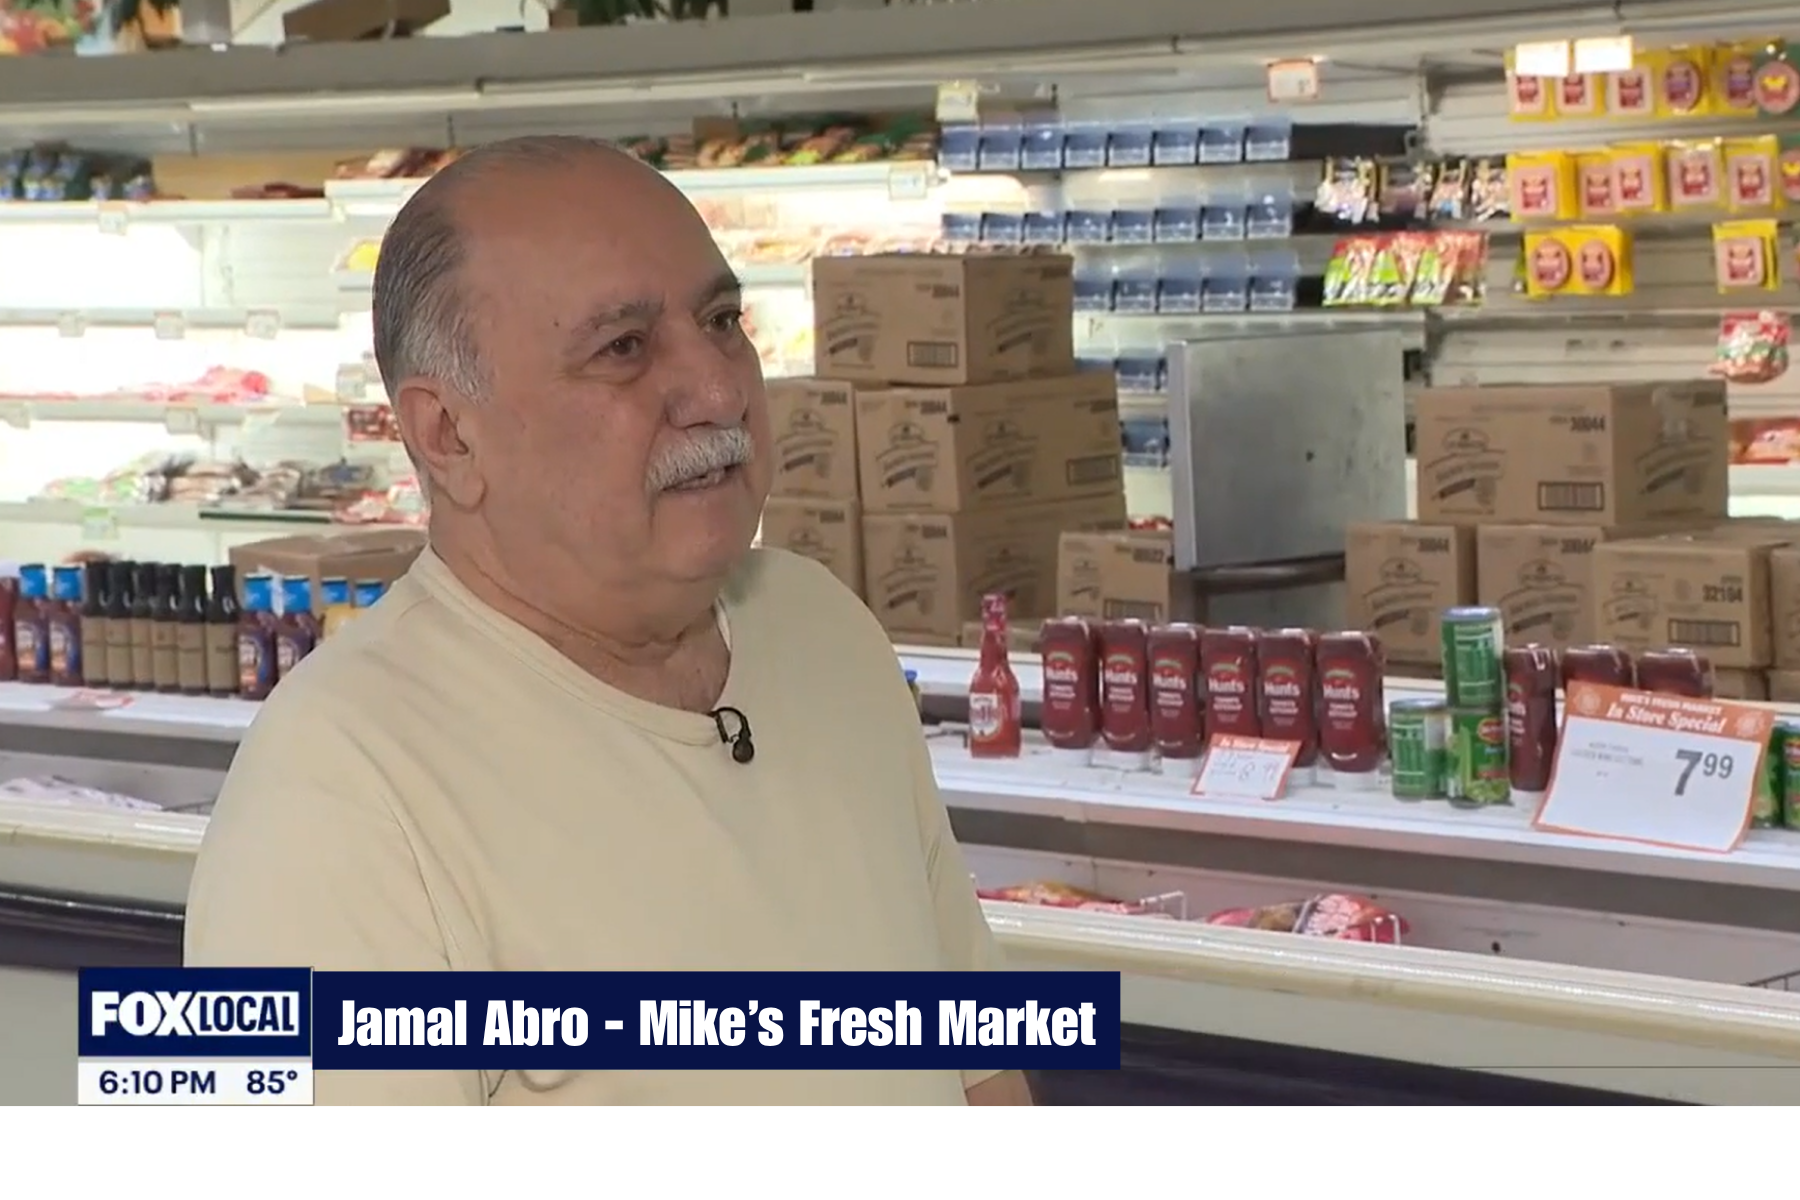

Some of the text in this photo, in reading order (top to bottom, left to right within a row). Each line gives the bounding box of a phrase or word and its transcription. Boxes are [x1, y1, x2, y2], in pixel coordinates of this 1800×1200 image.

[1606, 703, 1728, 734] In Store Special
